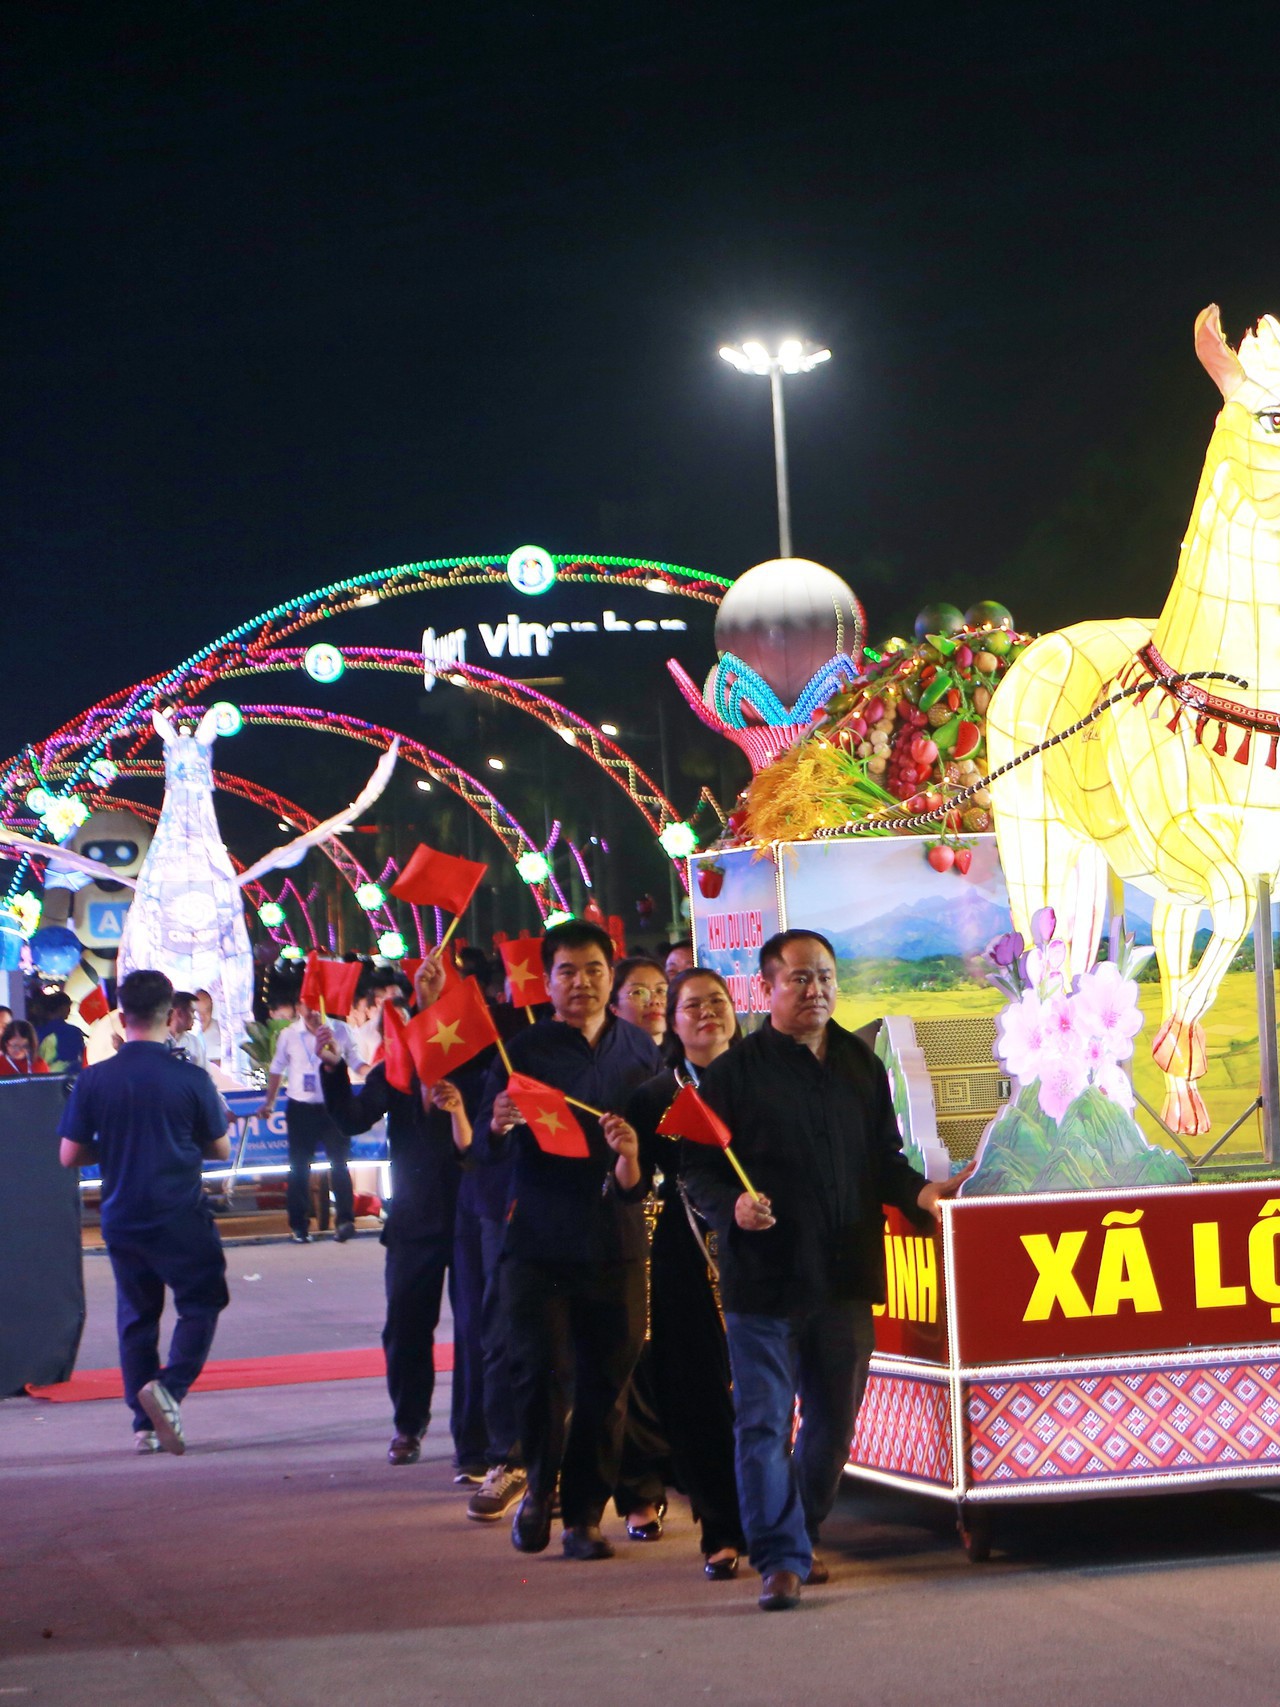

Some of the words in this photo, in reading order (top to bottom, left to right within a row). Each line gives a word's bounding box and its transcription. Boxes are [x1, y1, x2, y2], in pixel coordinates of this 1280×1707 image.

[708, 913, 727, 952] KHU
[729, 913, 742, 950] DU
[742, 910, 764, 957] LỊCH
[873, 1236, 937, 1322] ÌNH
[1021, 1210, 1161, 1320] XÃ
